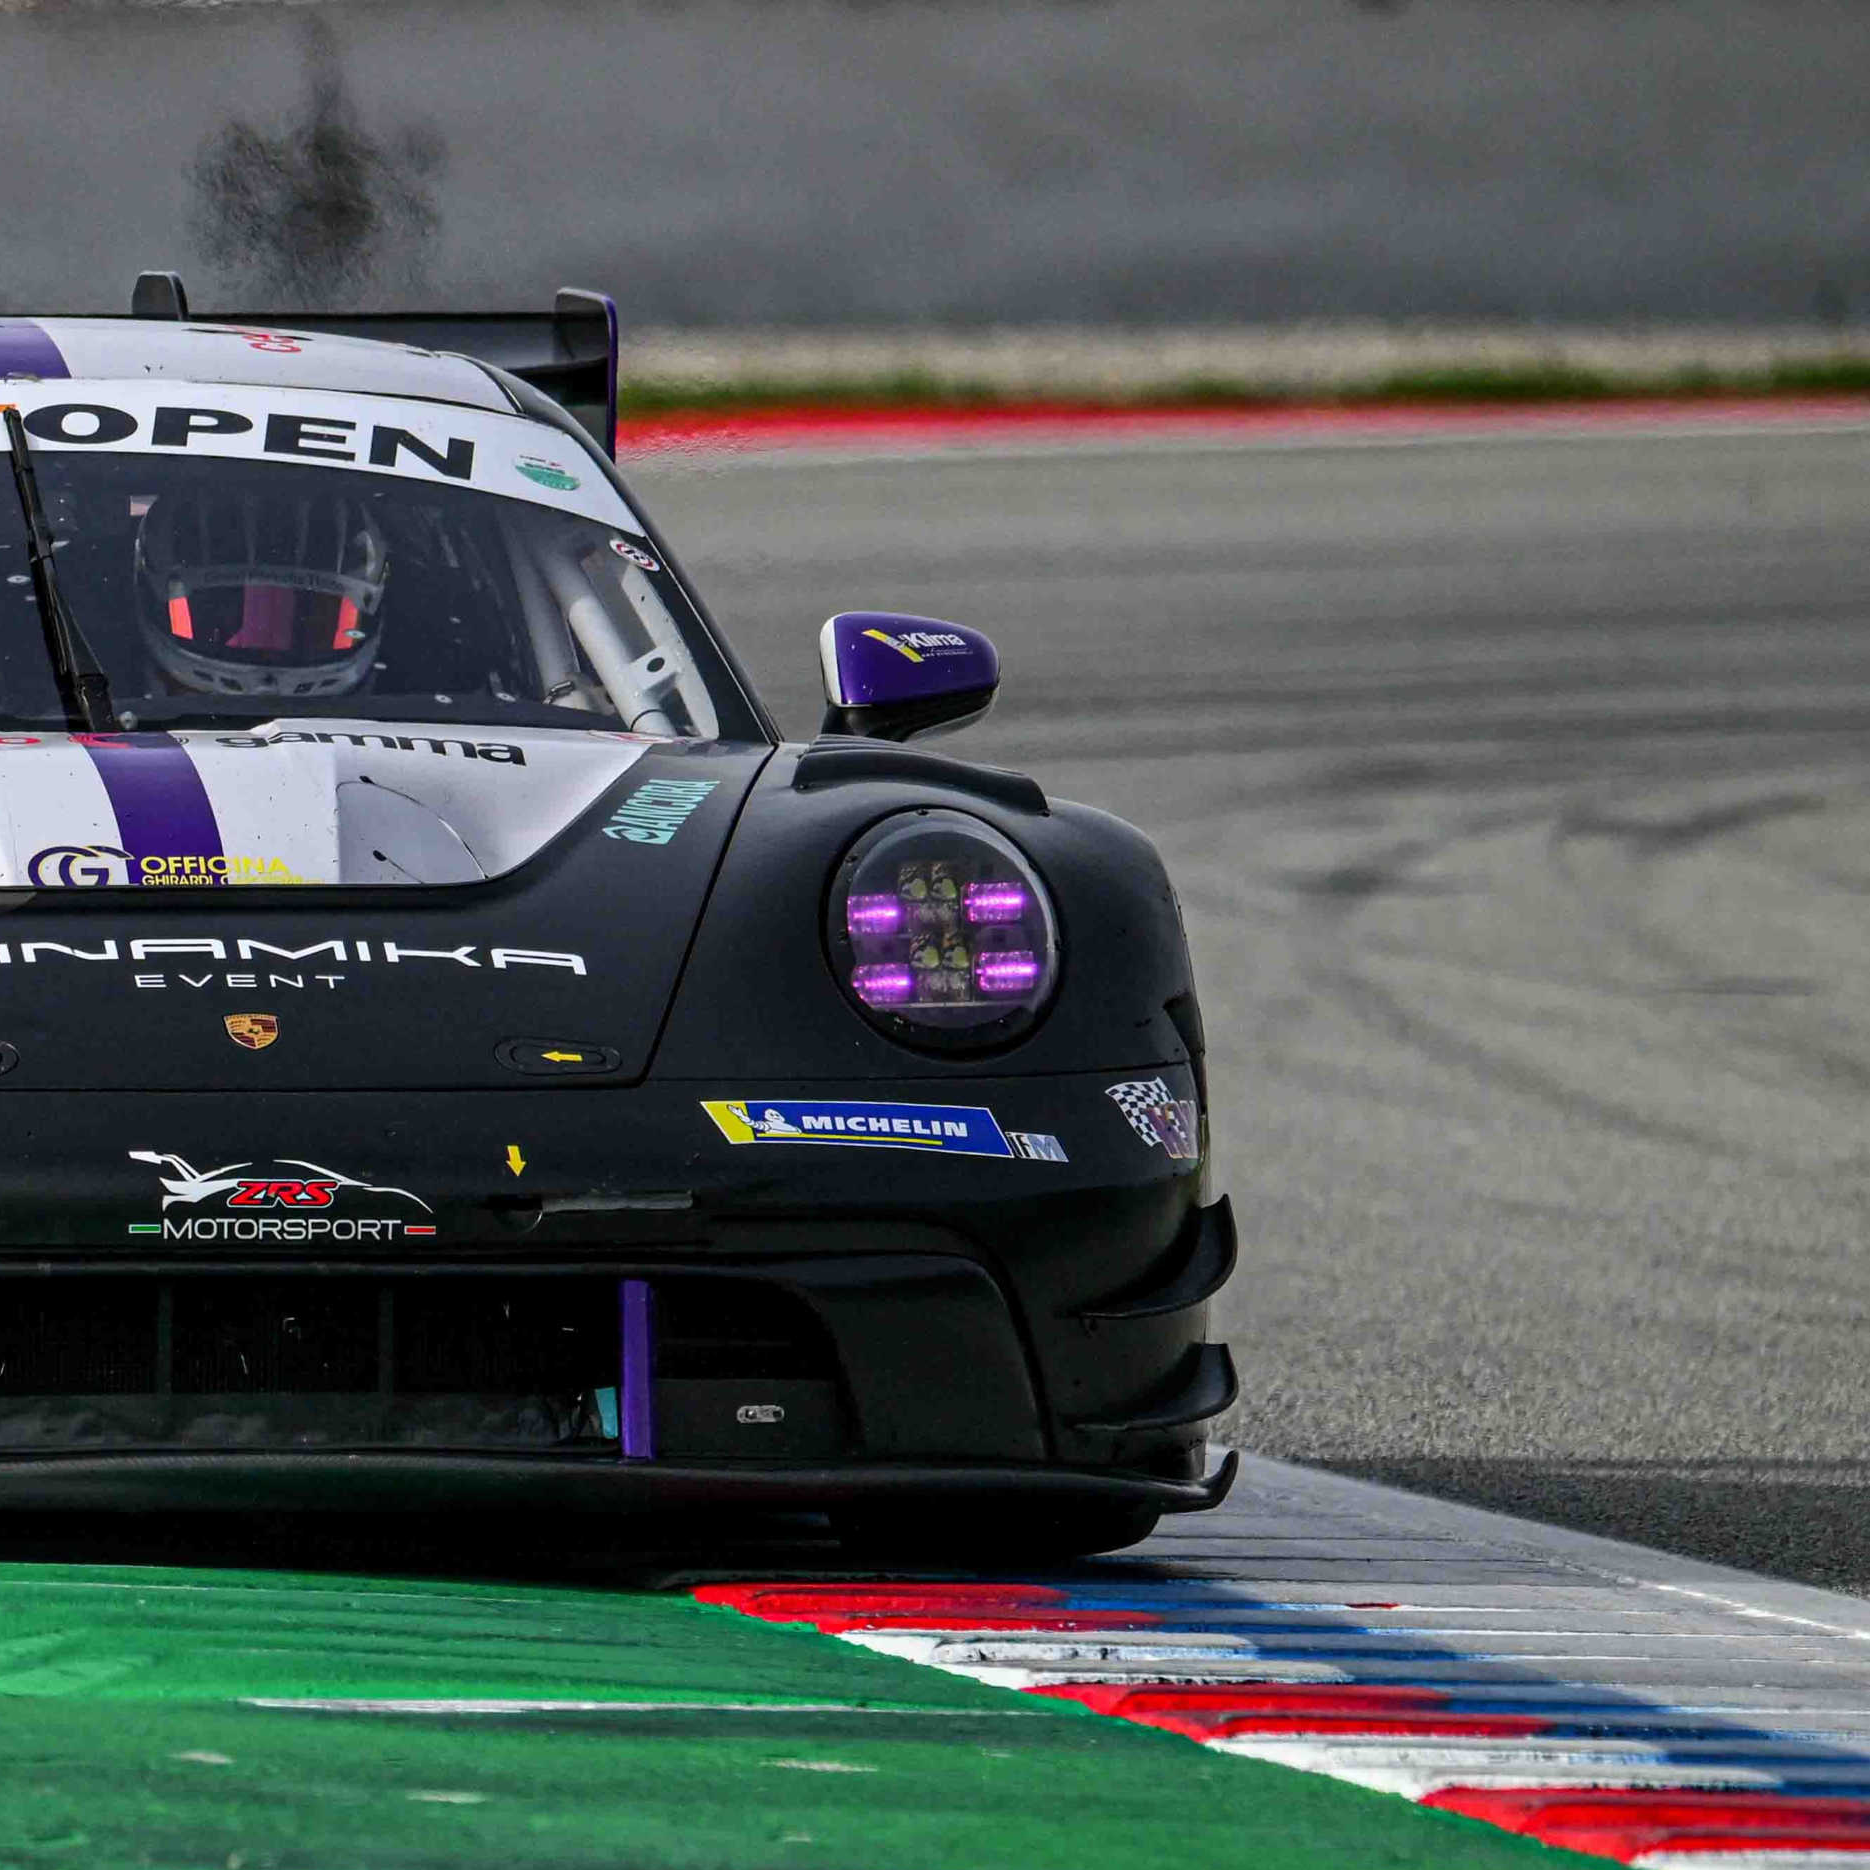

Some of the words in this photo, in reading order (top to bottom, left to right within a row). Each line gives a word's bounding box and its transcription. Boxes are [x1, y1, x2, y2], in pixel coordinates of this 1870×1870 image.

[216, 731, 527, 766] gamma
[140, 855, 290, 875] OFFICINA
[134, 974, 346, 989] EVENT
[801, 1115, 967, 1137] MICHELIN
[163, 1218, 402, 1241] MOTORSPORT
